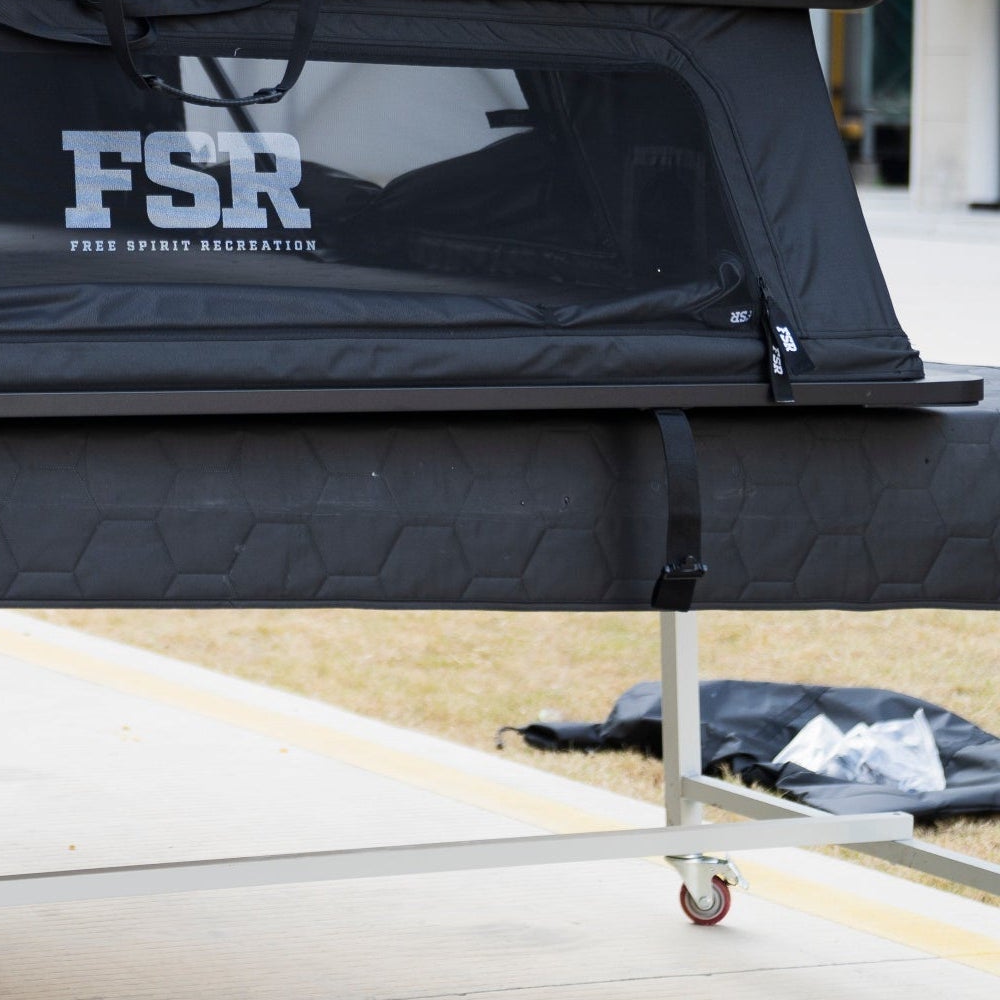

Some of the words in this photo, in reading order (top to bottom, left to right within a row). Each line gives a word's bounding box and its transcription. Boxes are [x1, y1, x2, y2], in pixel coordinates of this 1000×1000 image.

[62, 130, 312, 229] FSR
[70, 240, 117, 252] FREE
[126, 240, 191, 252] SPIRIT
[200, 240, 317, 252] RECREATION
[776, 326, 798, 352] FSR
[772, 345, 784, 375] FSR
